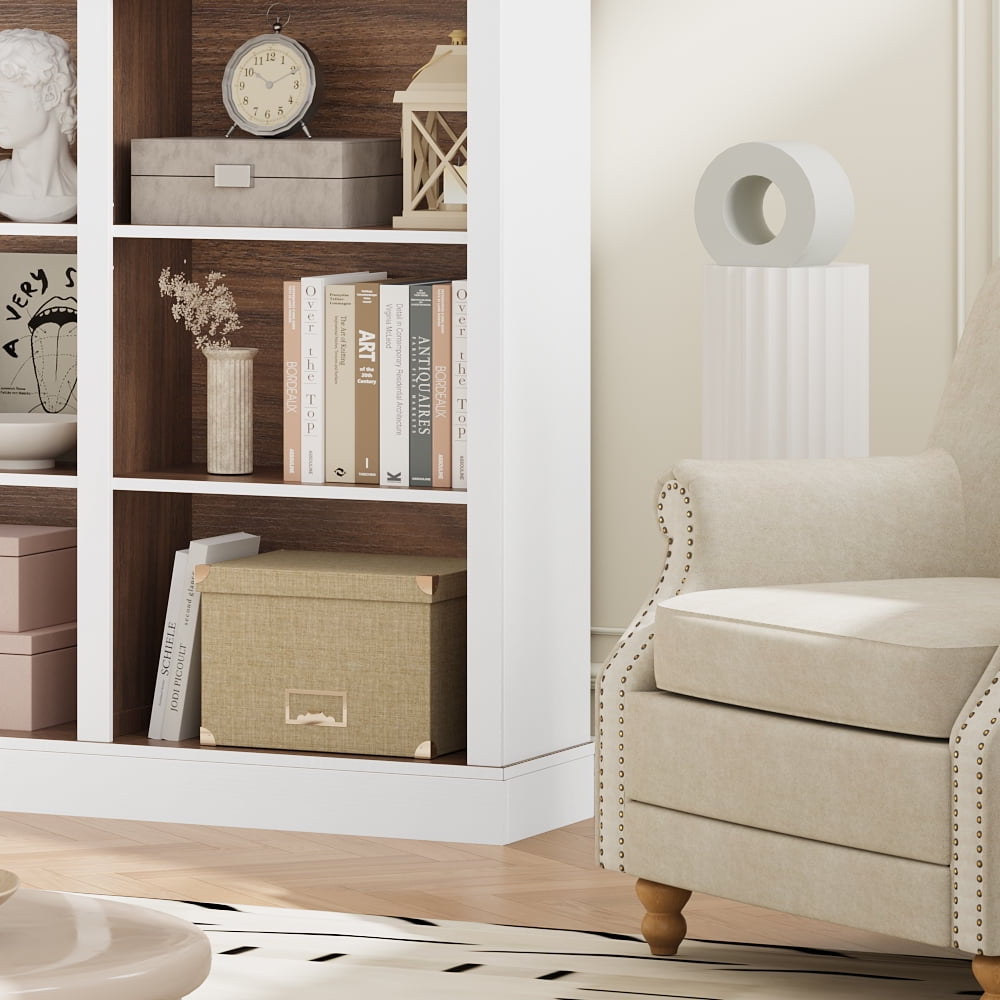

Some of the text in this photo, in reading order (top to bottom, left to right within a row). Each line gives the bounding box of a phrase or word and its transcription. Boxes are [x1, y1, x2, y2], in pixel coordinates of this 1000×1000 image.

[254, 57, 263, 65] 11
[266, 52, 275, 61] 12
[281, 56, 285, 64] 1
[245, 68, 254, 77] 10
[240, 81, 245, 90] 9
[293, 81, 299, 89] 3
[243, 96, 249, 105] 8
[288, 96, 293, 104] 4
[253, 107, 258, 116] 7
[264, 110, 270, 119] 6
[277, 107, 284, 115] 5
[6, 268, 48, 320] VERY
[2, 339, 20, 358] A
[359, 329, 376, 362] ART
[287, 361, 297, 413] BORDEAUX
[418, 336, 431, 435] ANTIQUAIRES
[435, 365, 446, 418] BORDEAUX
[386, 472, 401, 482] K
[184, 599, 192, 625] second
[162, 622, 177, 676] SCHIELE
[170, 643, 187, 712] JODI PICOULT
